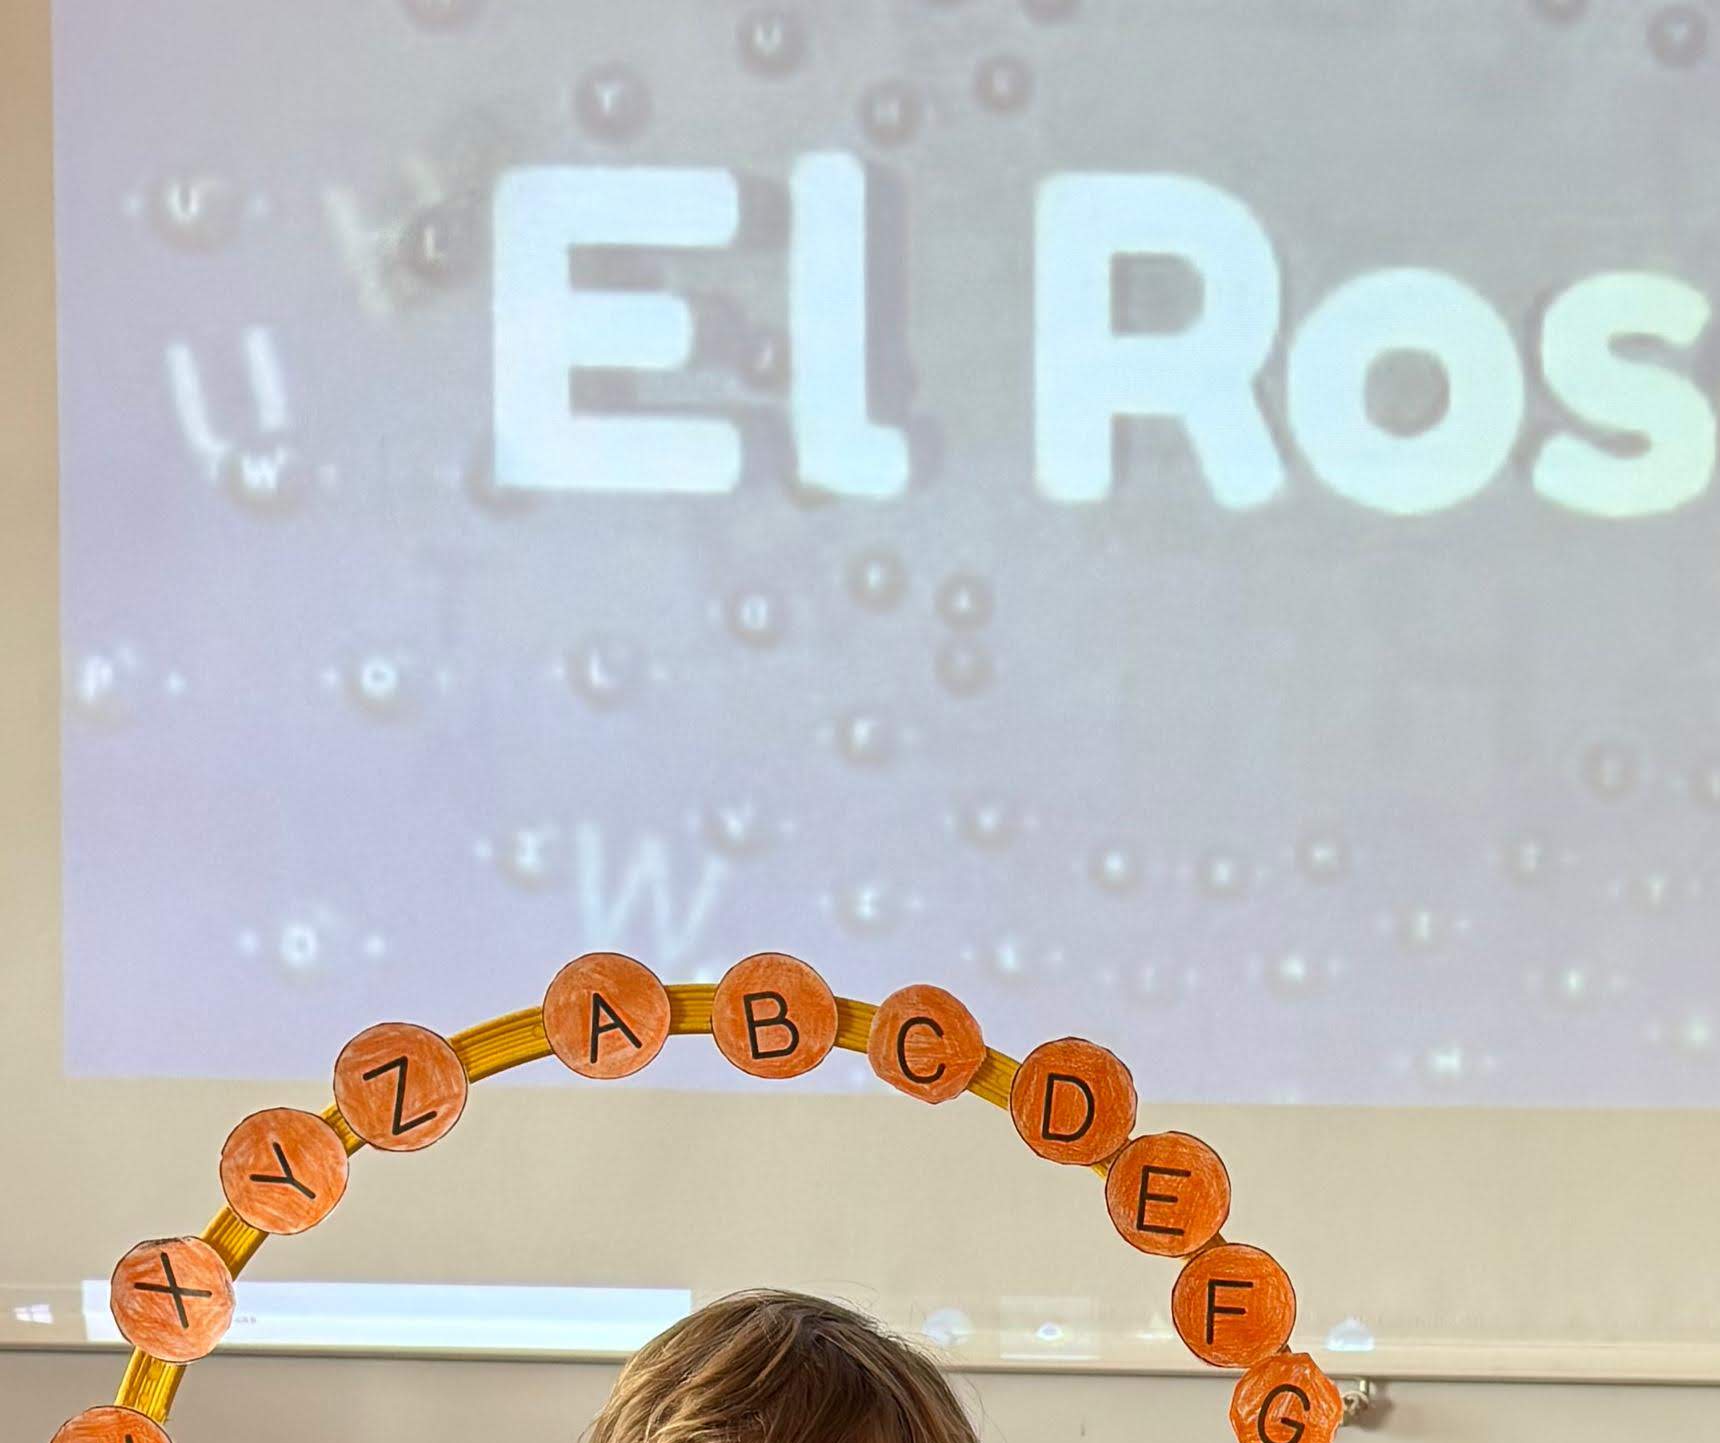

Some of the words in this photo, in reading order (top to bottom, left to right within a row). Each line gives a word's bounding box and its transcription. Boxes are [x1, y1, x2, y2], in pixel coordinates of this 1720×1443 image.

[492, 150, 909, 499] El
[591, 993, 641, 1063] A
[744, 992, 799, 1059] B
[897, 1017, 945, 1083] C
[363, 1057, 436, 1135] Z
[1042, 1074, 1094, 1142] D
[250, 1143, 315, 1199] Y
[1137, 1166, 1190, 1235] E
[134, 1252, 212, 1328] X
[1207, 1280, 1253, 1344] F
